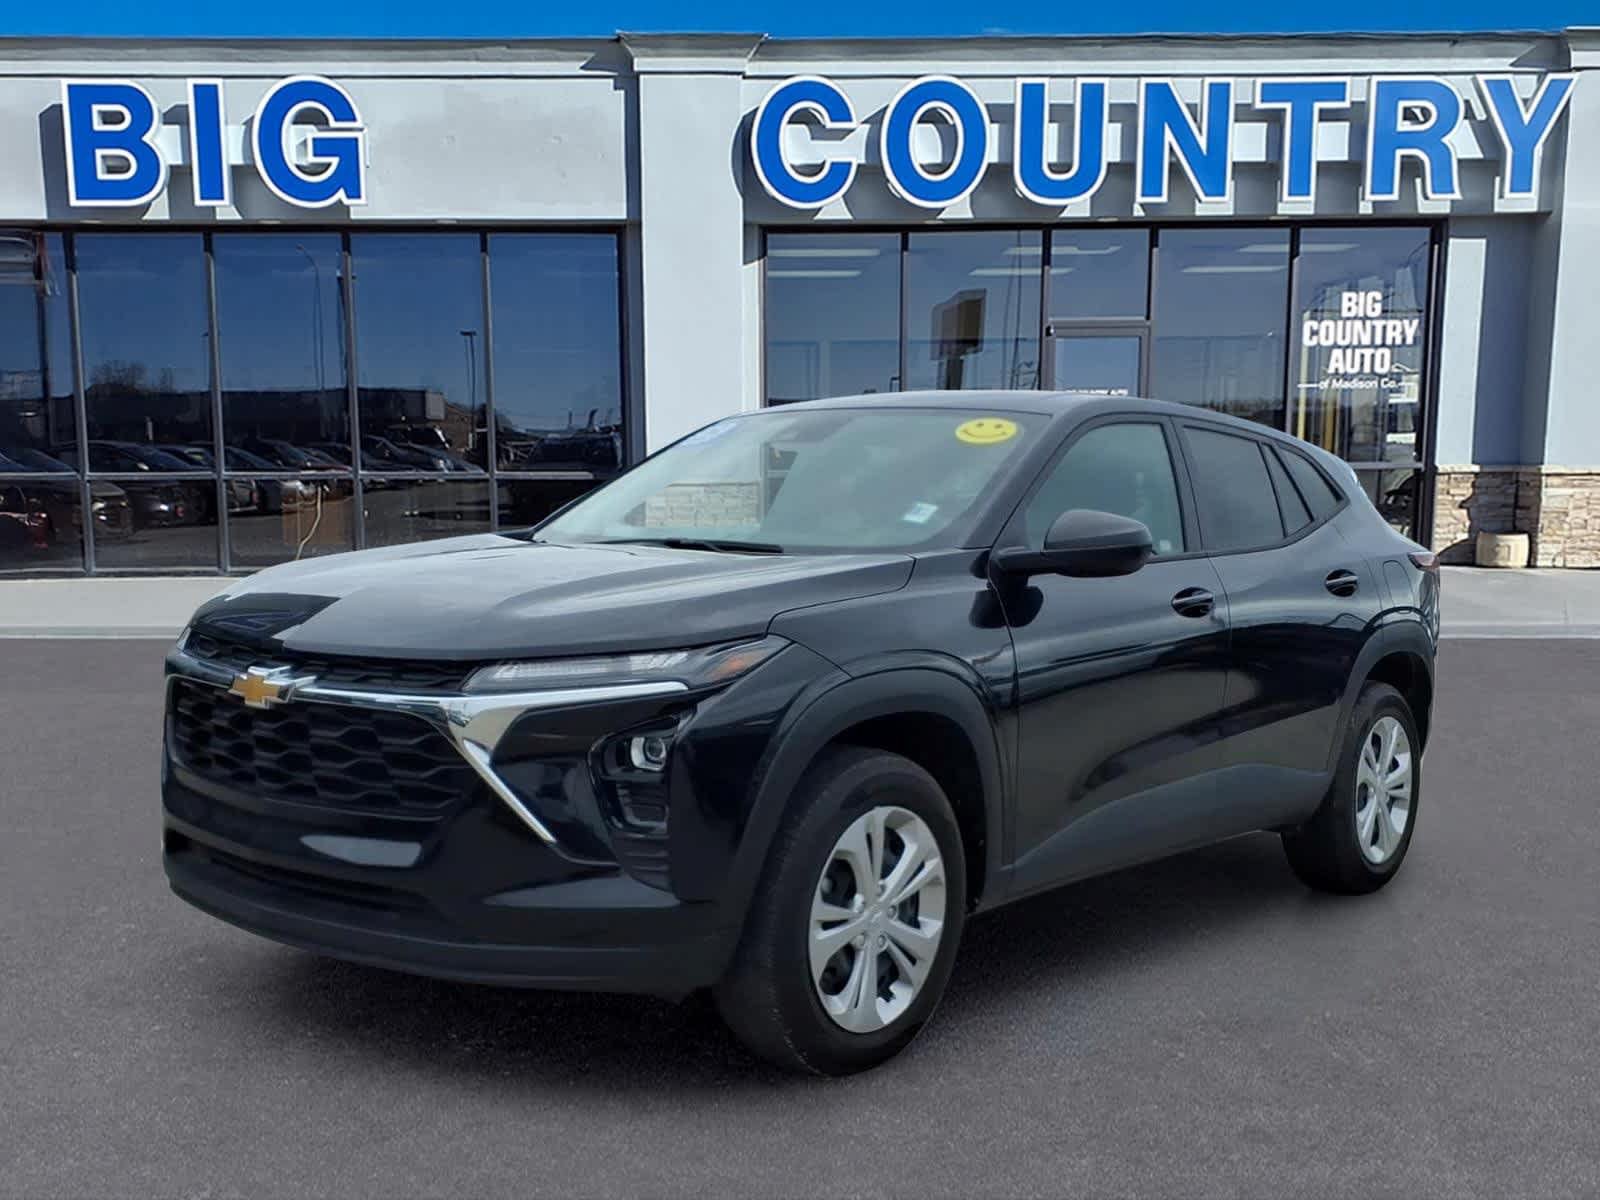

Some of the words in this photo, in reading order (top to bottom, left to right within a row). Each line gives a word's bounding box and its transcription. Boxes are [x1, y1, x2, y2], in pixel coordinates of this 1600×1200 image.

[61, 75, 367, 208] BIG
[751, 73, 1574, 210] COUNTRY
[1342, 291, 1382, 317] BIG
[1303, 320, 1419, 346] COUNTRY
[1328, 348, 1391, 374] AUTO
[1319, 377, 1329, 389] of
[1331, 377, 1378, 388] Madison
